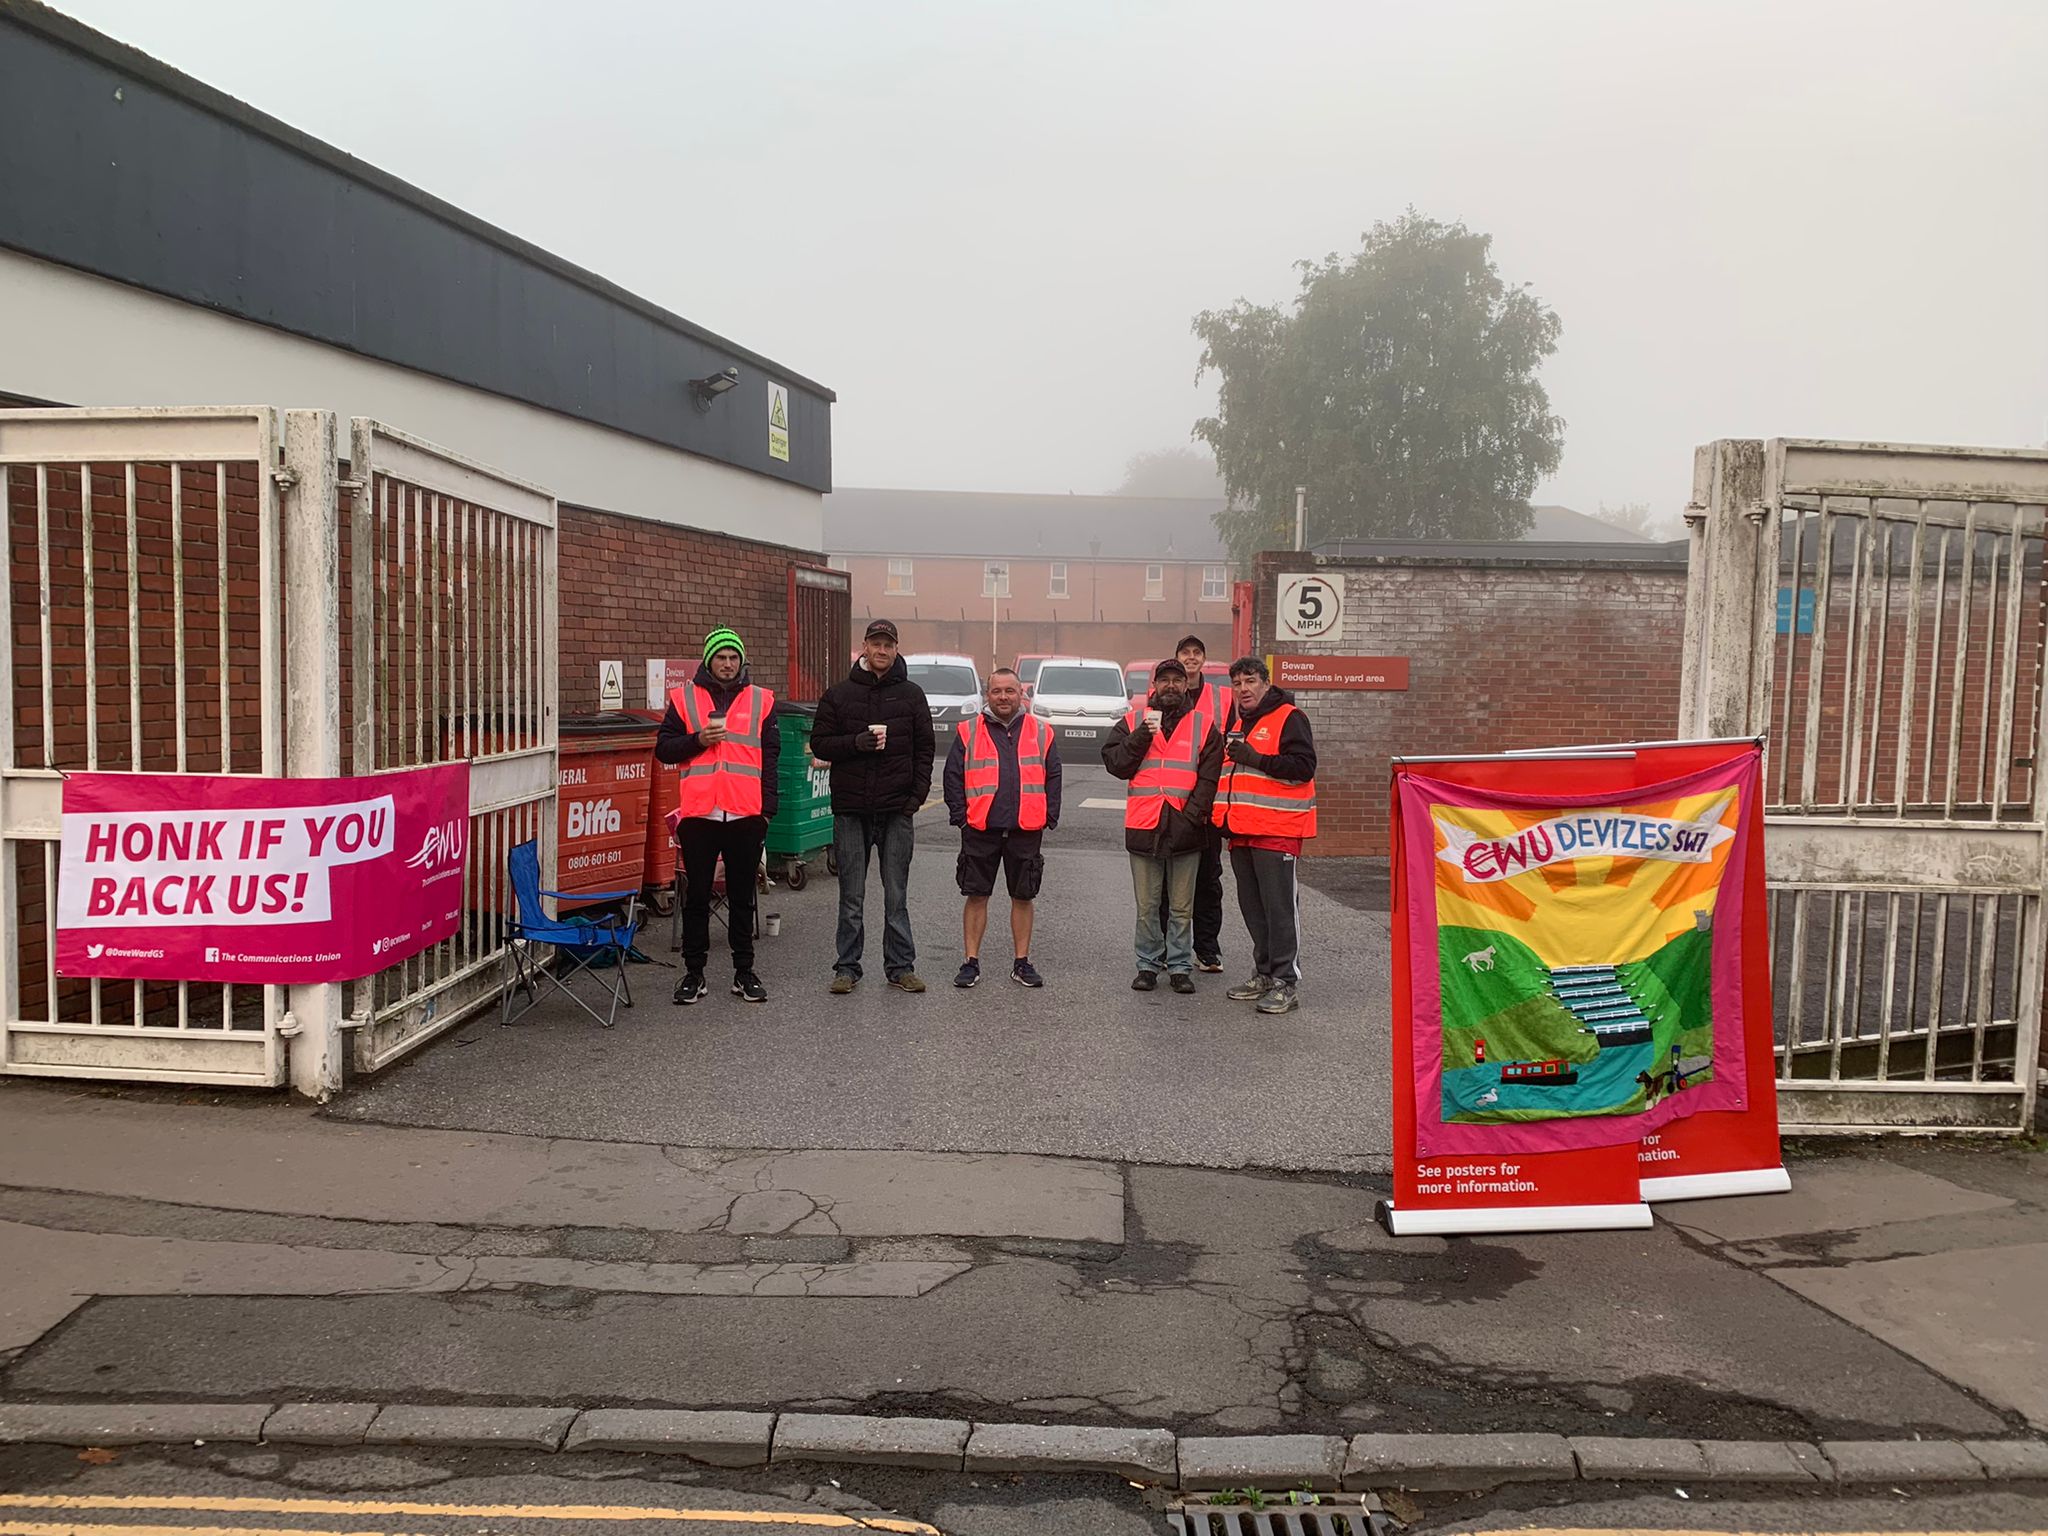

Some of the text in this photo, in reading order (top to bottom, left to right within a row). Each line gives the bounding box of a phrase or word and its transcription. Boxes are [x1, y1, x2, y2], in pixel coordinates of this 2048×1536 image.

[1298, 586, 1323, 620] 5
[1297, 620, 1323, 630] MPH
[1281, 661, 1315, 671] Beware
[1281, 673, 1385, 685] Pedestrians in yard area
[615, 763, 646, 780] WASTE
[812, 769, 832, 799] Biff
[567, 798, 621, 839] Biffa
[85, 807, 386, 863] HONK IF YOU
[1463, 818, 1709, 879] CWU DEVIZES SW7
[86, 871, 309, 916] BACK US!
[105, 947, 164, 959] @DaveWardGS
[221, 952, 342, 963] The Communications Union
[1417, 1162, 1521, 1179] See posters for
[1417, 1179, 1539, 1194] more information.
